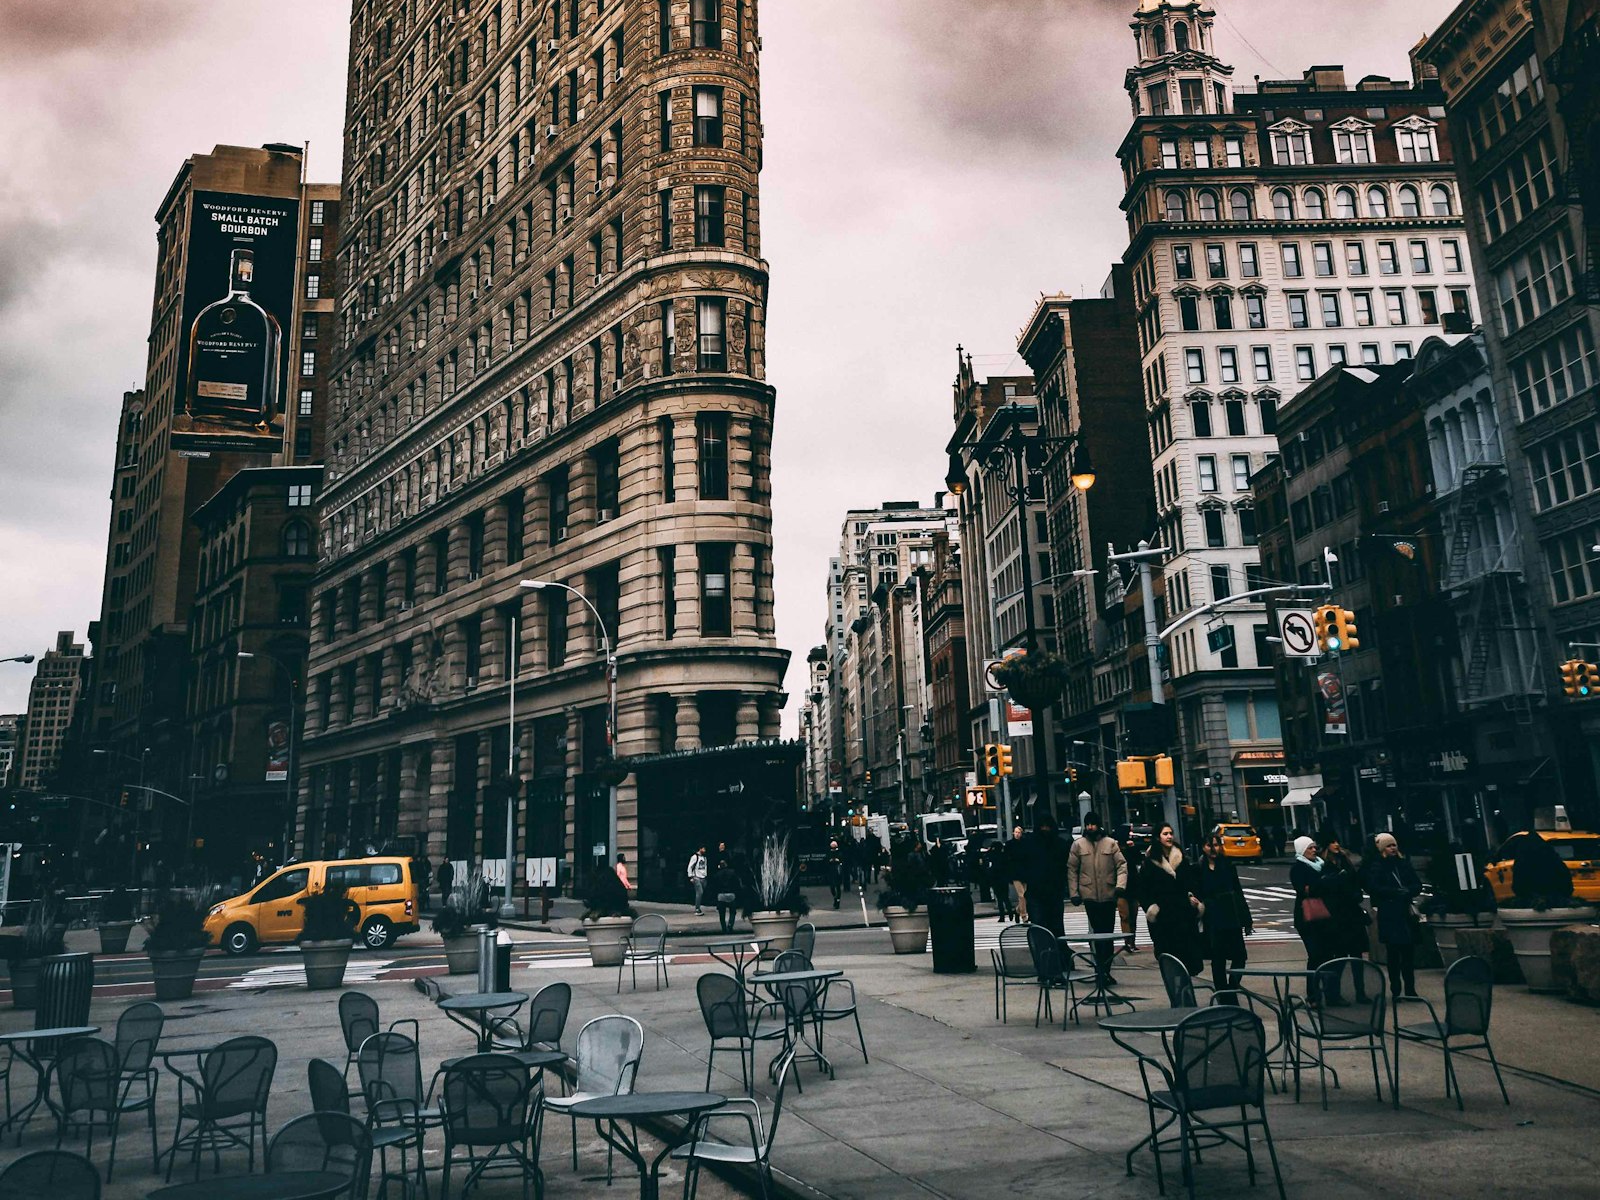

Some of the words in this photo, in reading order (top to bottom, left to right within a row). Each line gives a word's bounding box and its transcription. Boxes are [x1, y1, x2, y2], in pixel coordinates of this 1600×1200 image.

[202, 203, 248, 213] WOODFORD
[250, 207, 288, 217] RESERVE
[211, 212, 245, 224] SMALL
[247, 215, 279, 227] BATCH
[220, 223, 268, 236] BOURBON
